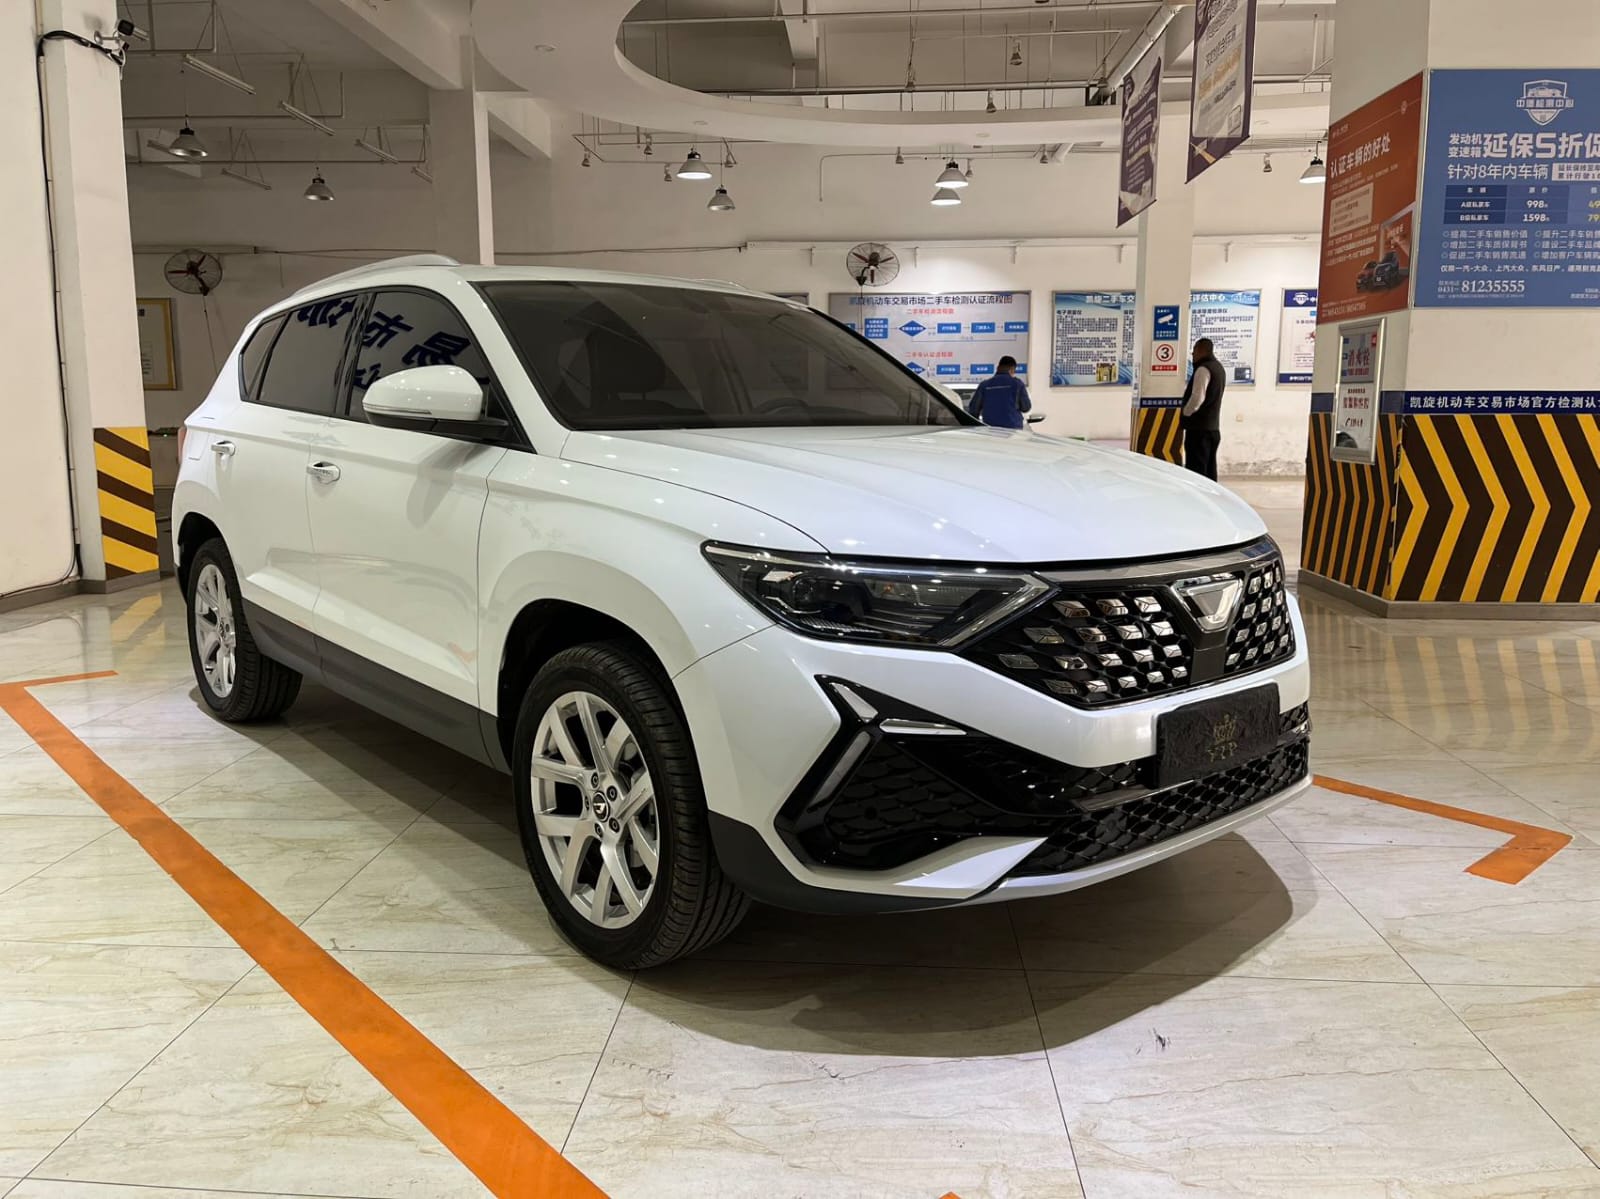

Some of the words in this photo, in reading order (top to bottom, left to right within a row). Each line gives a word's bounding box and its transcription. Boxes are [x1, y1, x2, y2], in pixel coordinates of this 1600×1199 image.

[1449, 133, 1482, 145] 发动机
[1330, 132, 1391, 178] 认证车辆的好处
[1448, 147, 1481, 158] 变速箱
[1448, 163, 1549, 180] 针对8年内车辆
[1461, 280, 1525, 293] 81235555
[1160, 347, 1170, 359] 3
[1409, 396, 1600, 409] 凯旋机动车交易市场官方检测认
